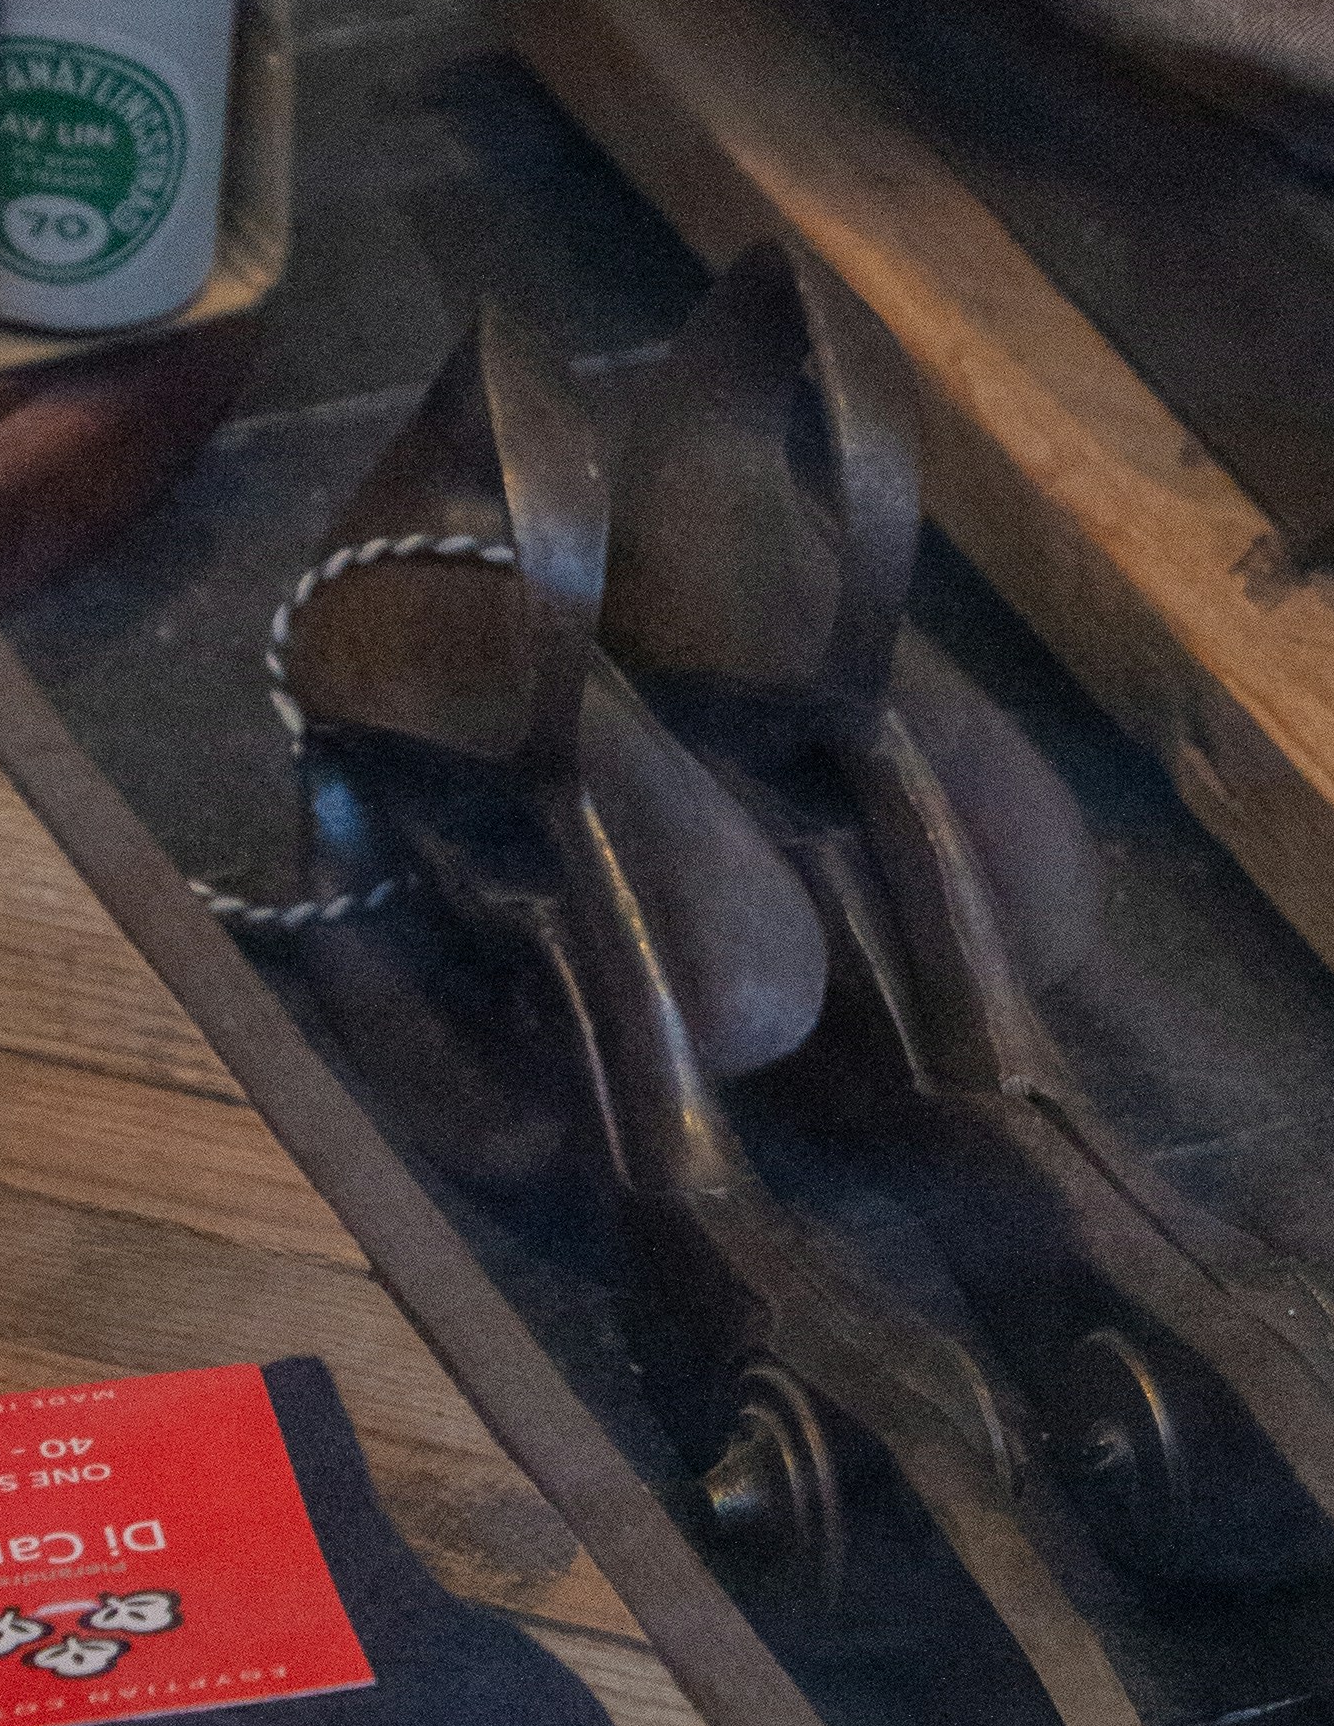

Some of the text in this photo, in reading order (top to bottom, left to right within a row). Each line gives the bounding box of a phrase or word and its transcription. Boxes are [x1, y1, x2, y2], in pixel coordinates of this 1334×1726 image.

[18, 207, 89, 240] 70
[30, 1388, 115, 1410] MADE
[38, 1435, 95, 1462] 40
[29, 1462, 113, 1491] ONE
[105, 1519, 167, 1558] Di
[89, 1666, 285, 1703] EGYPTIAN
